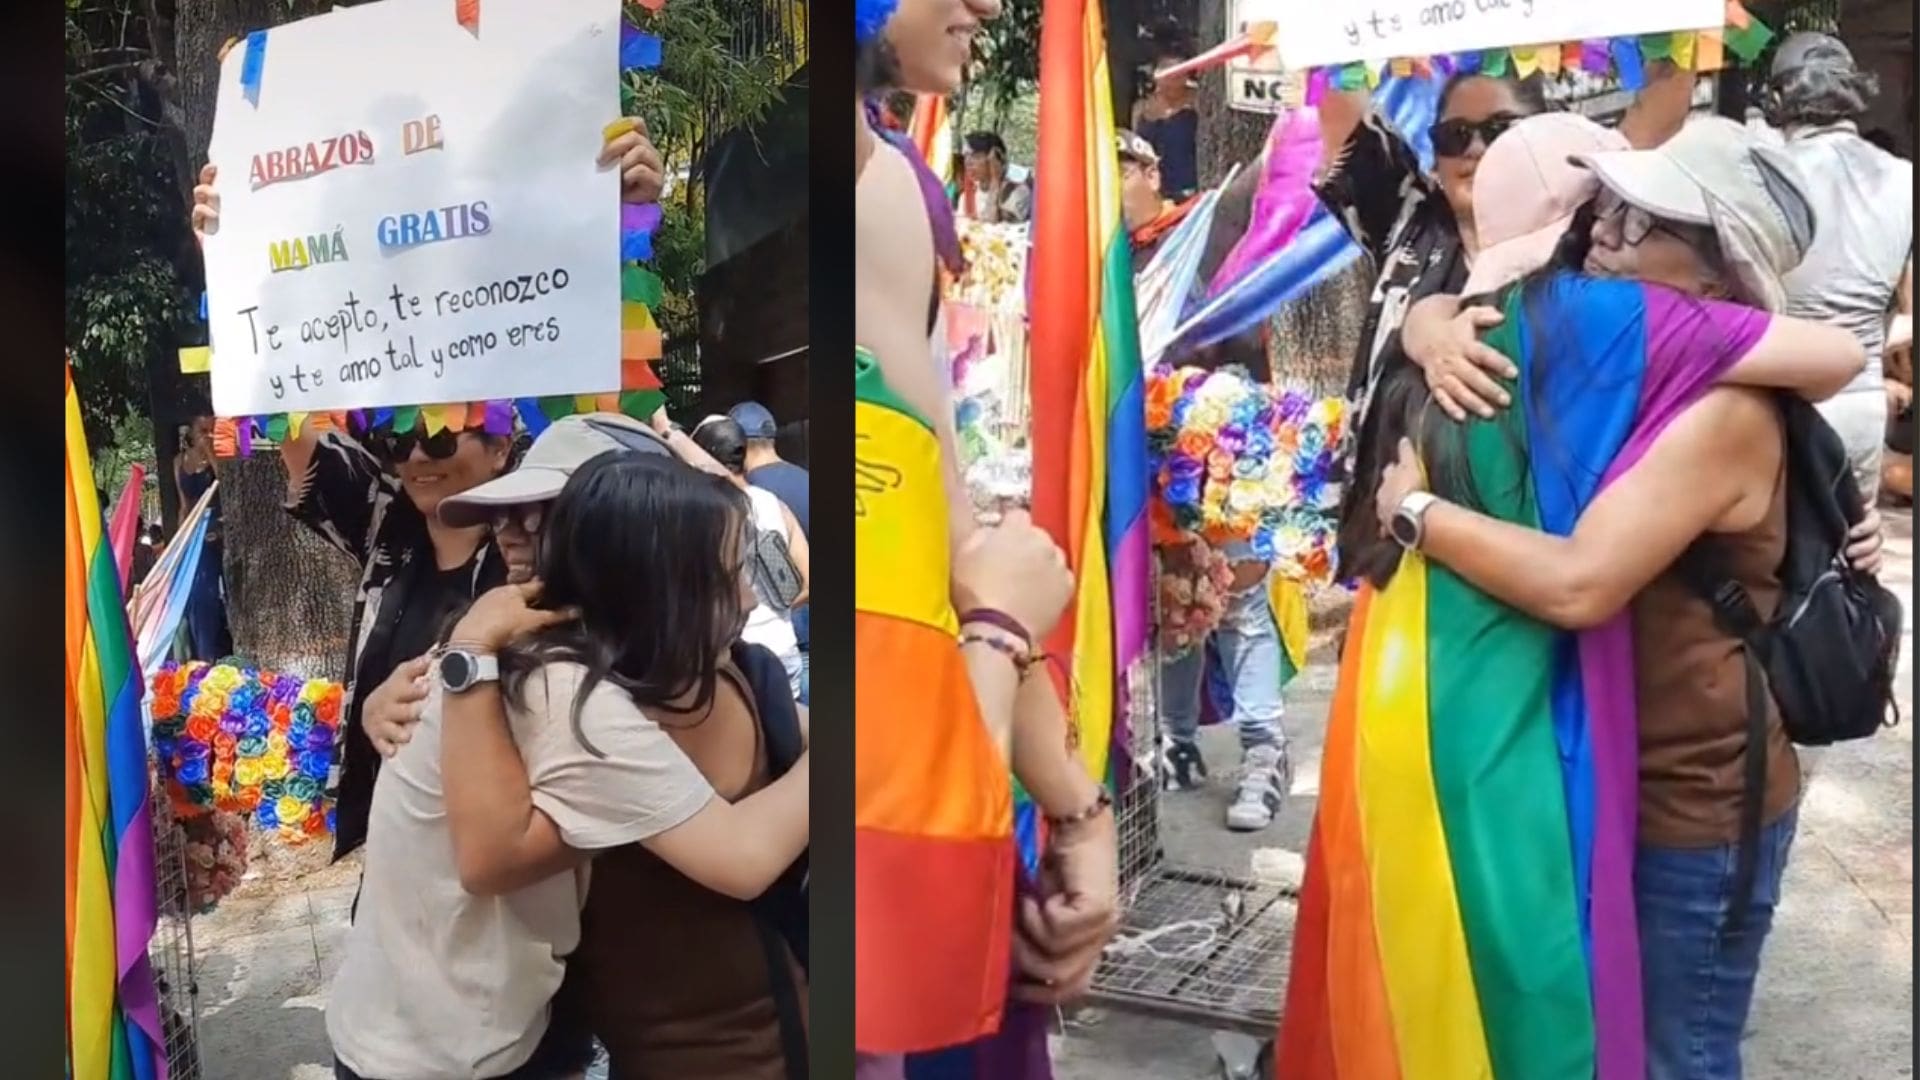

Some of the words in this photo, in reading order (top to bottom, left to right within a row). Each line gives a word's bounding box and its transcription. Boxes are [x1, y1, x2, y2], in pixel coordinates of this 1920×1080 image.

[1420, 0, 1465, 26] amo
[249, 130, 374, 186] ABRAZOS
[402, 114, 444, 155] DE
[269, 224, 349, 271] MAMÁ
[377, 200, 491, 250] GRATIS
[237, 305, 283, 355] Te
[300, 290, 389, 354] acepto,
[389, 283, 422, 320] te
[434, 268, 570, 316] reconozco
[269, 374, 285, 399] y
[290, 364, 324, 392] te
[339, 357, 382, 383] amo
[385, 335, 423, 371] tal
[431, 348, 444, 379] y
[448, 331, 498, 360] como
[506, 316, 561, 347] eres
